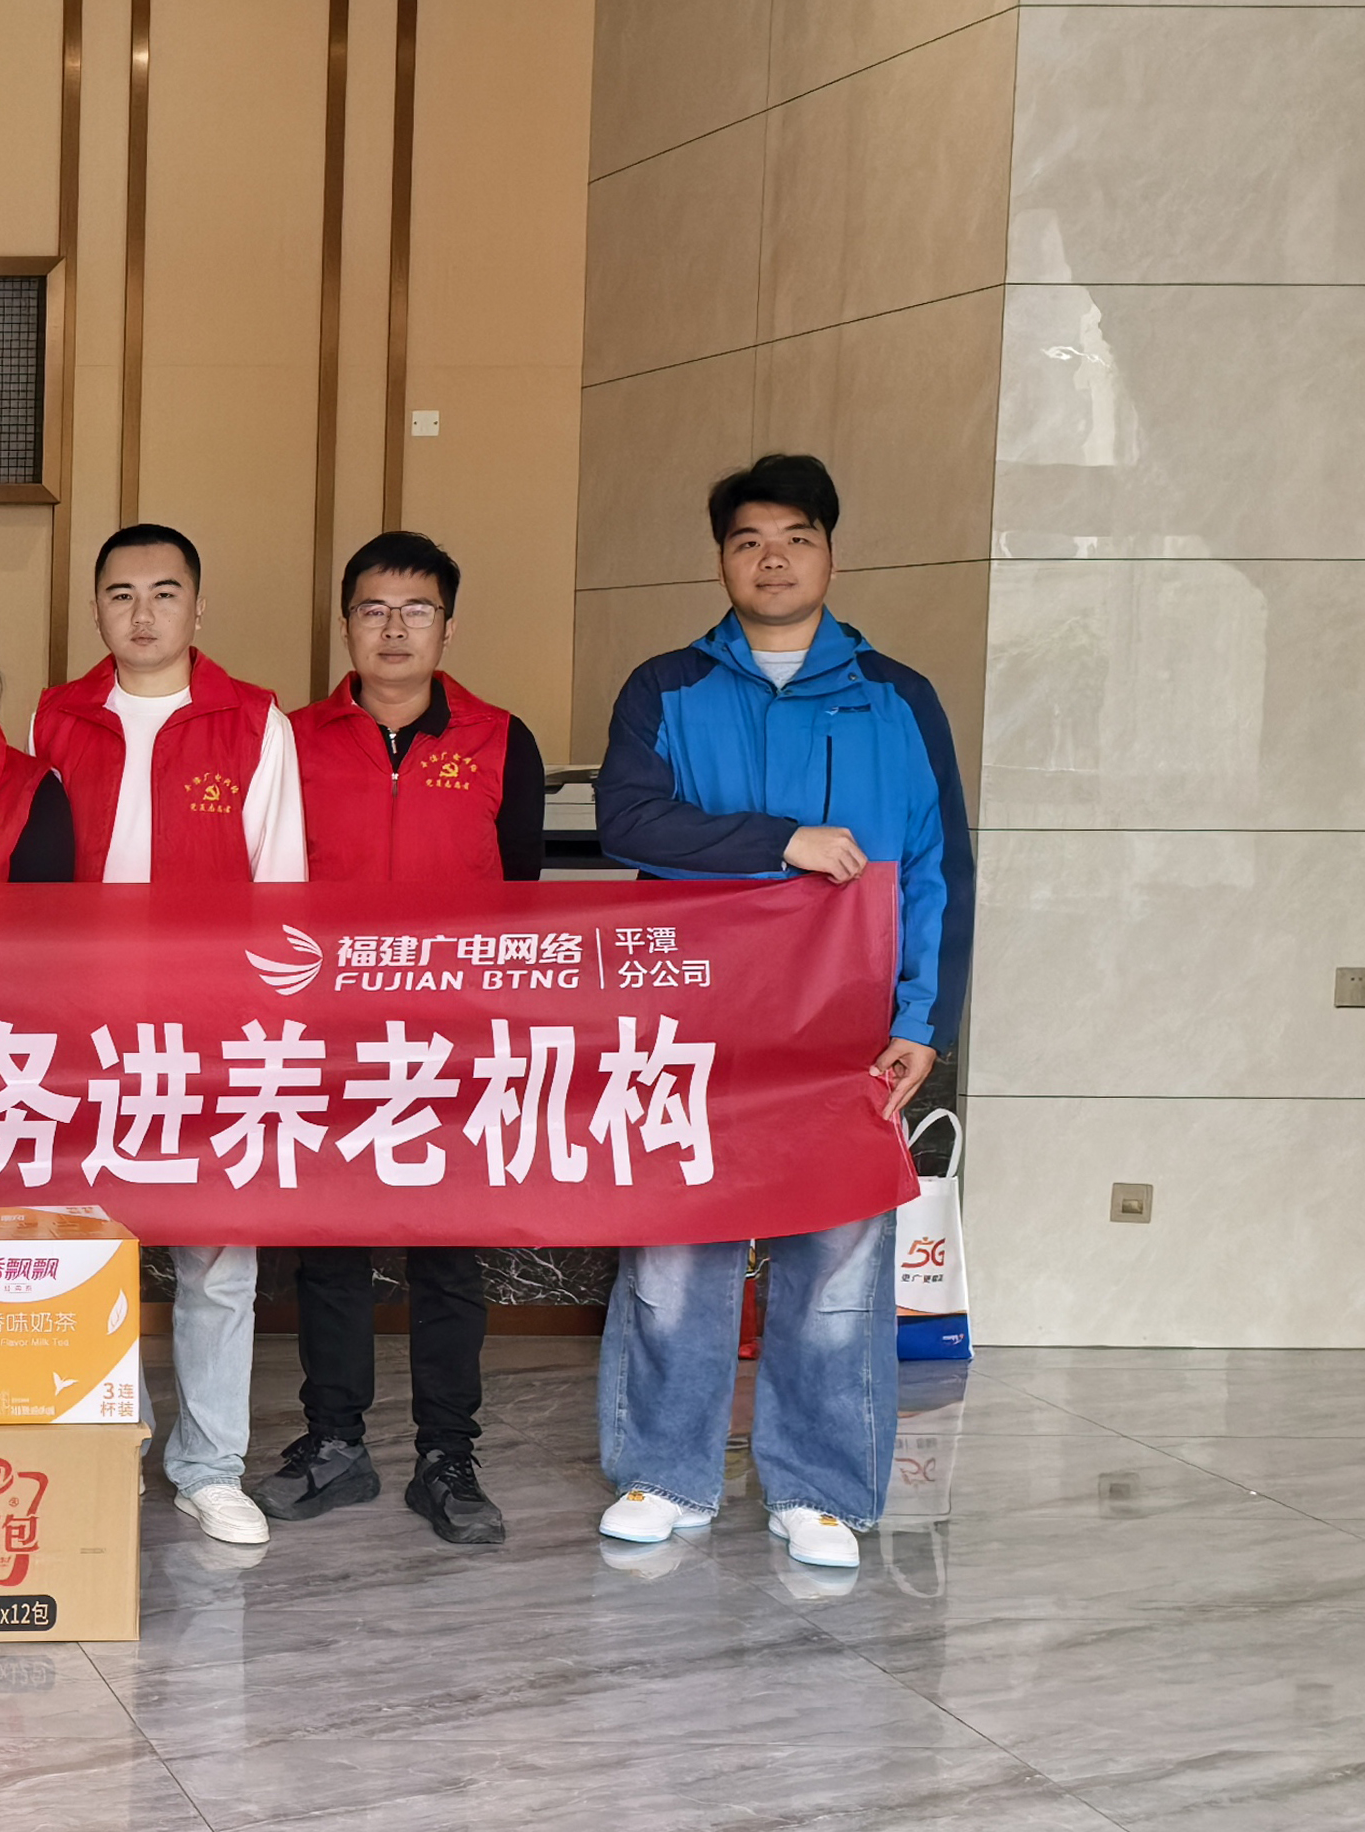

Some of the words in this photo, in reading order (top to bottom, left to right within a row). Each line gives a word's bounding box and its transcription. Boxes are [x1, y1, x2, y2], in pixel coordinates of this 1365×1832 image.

[336, 932, 583, 967] 福建广电网络
[615, 926, 679, 955] 平潭
[335, 971, 464, 991] FUJIAN
[482, 969, 580, 989] BTNG
[617, 959, 711, 989] 分公司
[901, 1236, 946, 1268] 5G
[1, 1338, 28, 1347] Flavor
[31, 1338, 49, 1347] Milk
[52, 1338, 70, 1347] Tea
[100, 1401, 135, 1418] 杯装
